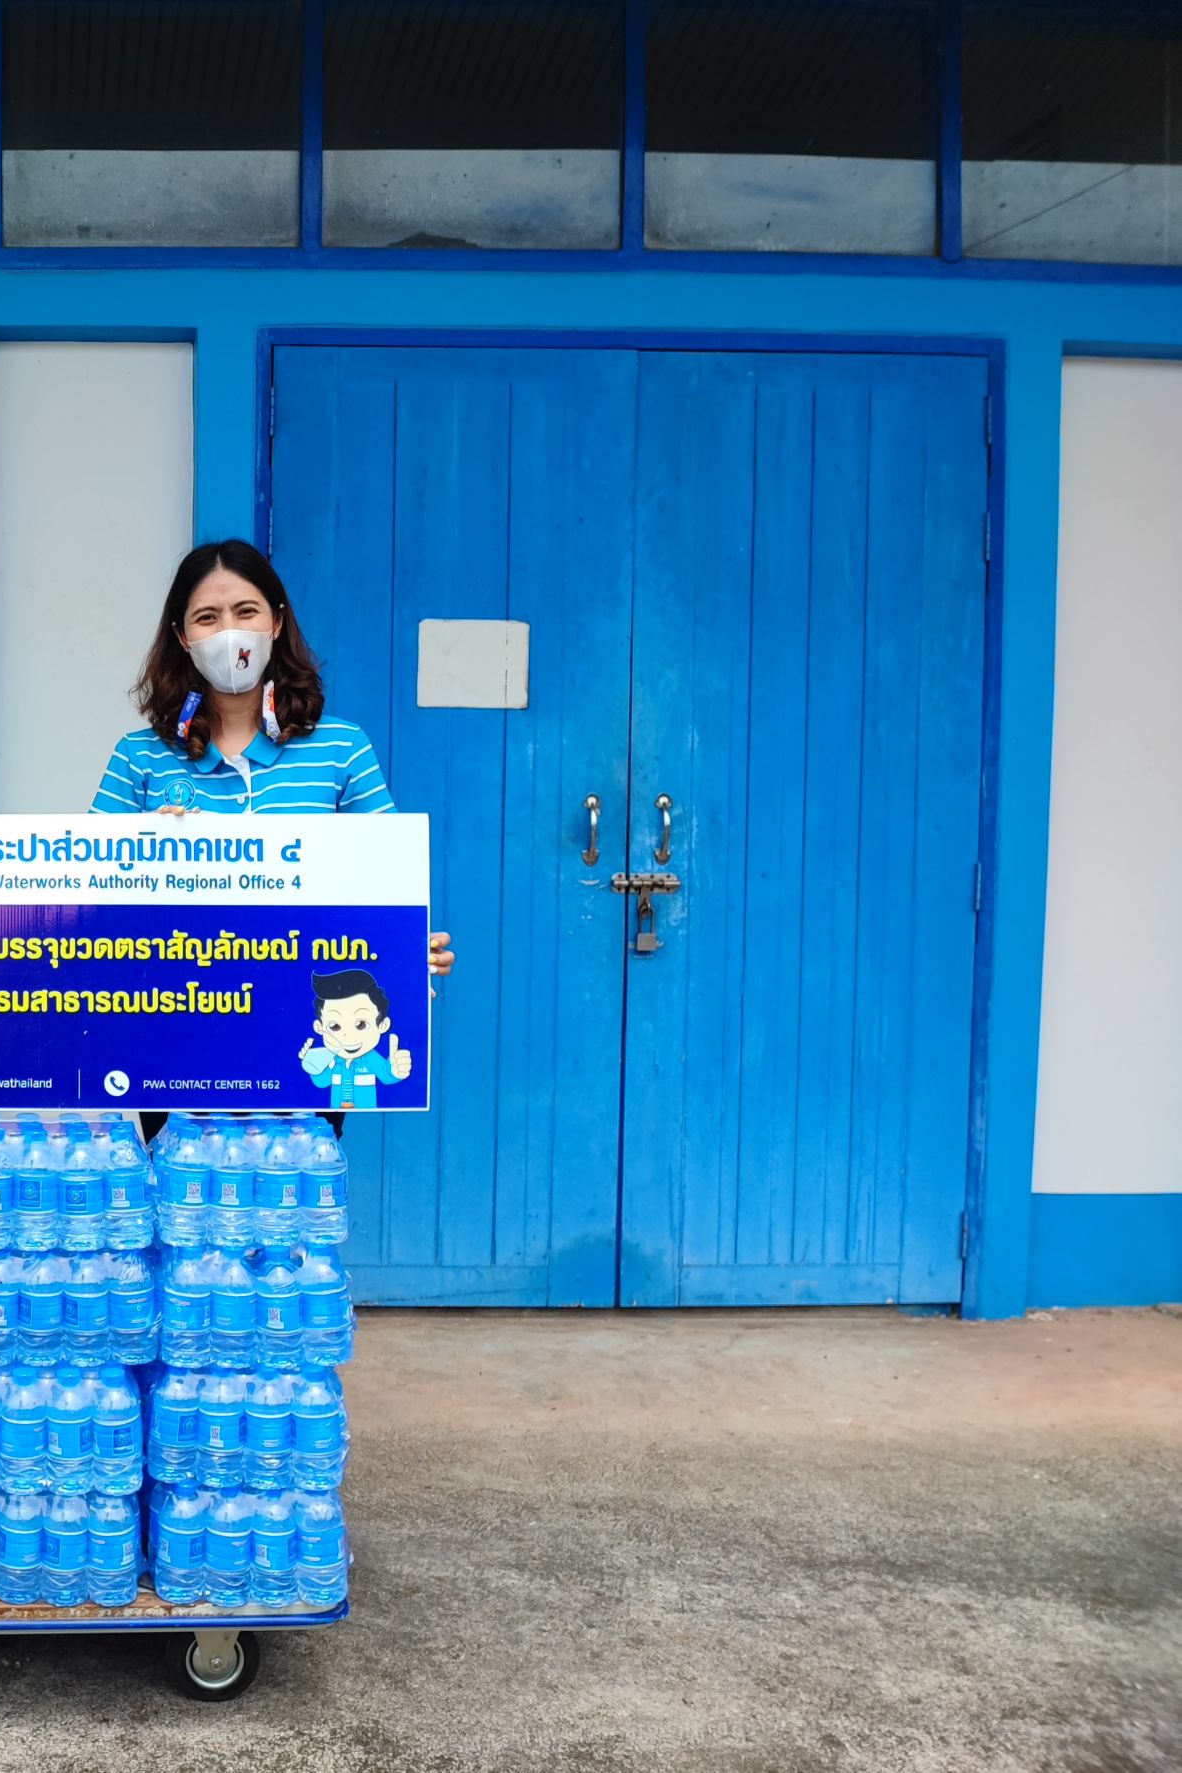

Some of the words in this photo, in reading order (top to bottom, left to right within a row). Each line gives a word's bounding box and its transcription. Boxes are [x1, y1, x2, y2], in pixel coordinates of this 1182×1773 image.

[280, 838, 302, 863] ๔
[88, 874, 159, 892] Authority
[165, 873, 232, 893] Regional
[238, 874, 285, 890] Office
[291, 875, 302, 890] 4
[311, 935, 378, 961] กปภ.
[143, 1079, 167, 1089] PWA
[169, 1079, 212, 1090] CONTACT
[214, 1080, 253, 1090] CENTER
[255, 1080, 280, 1090] 1662
